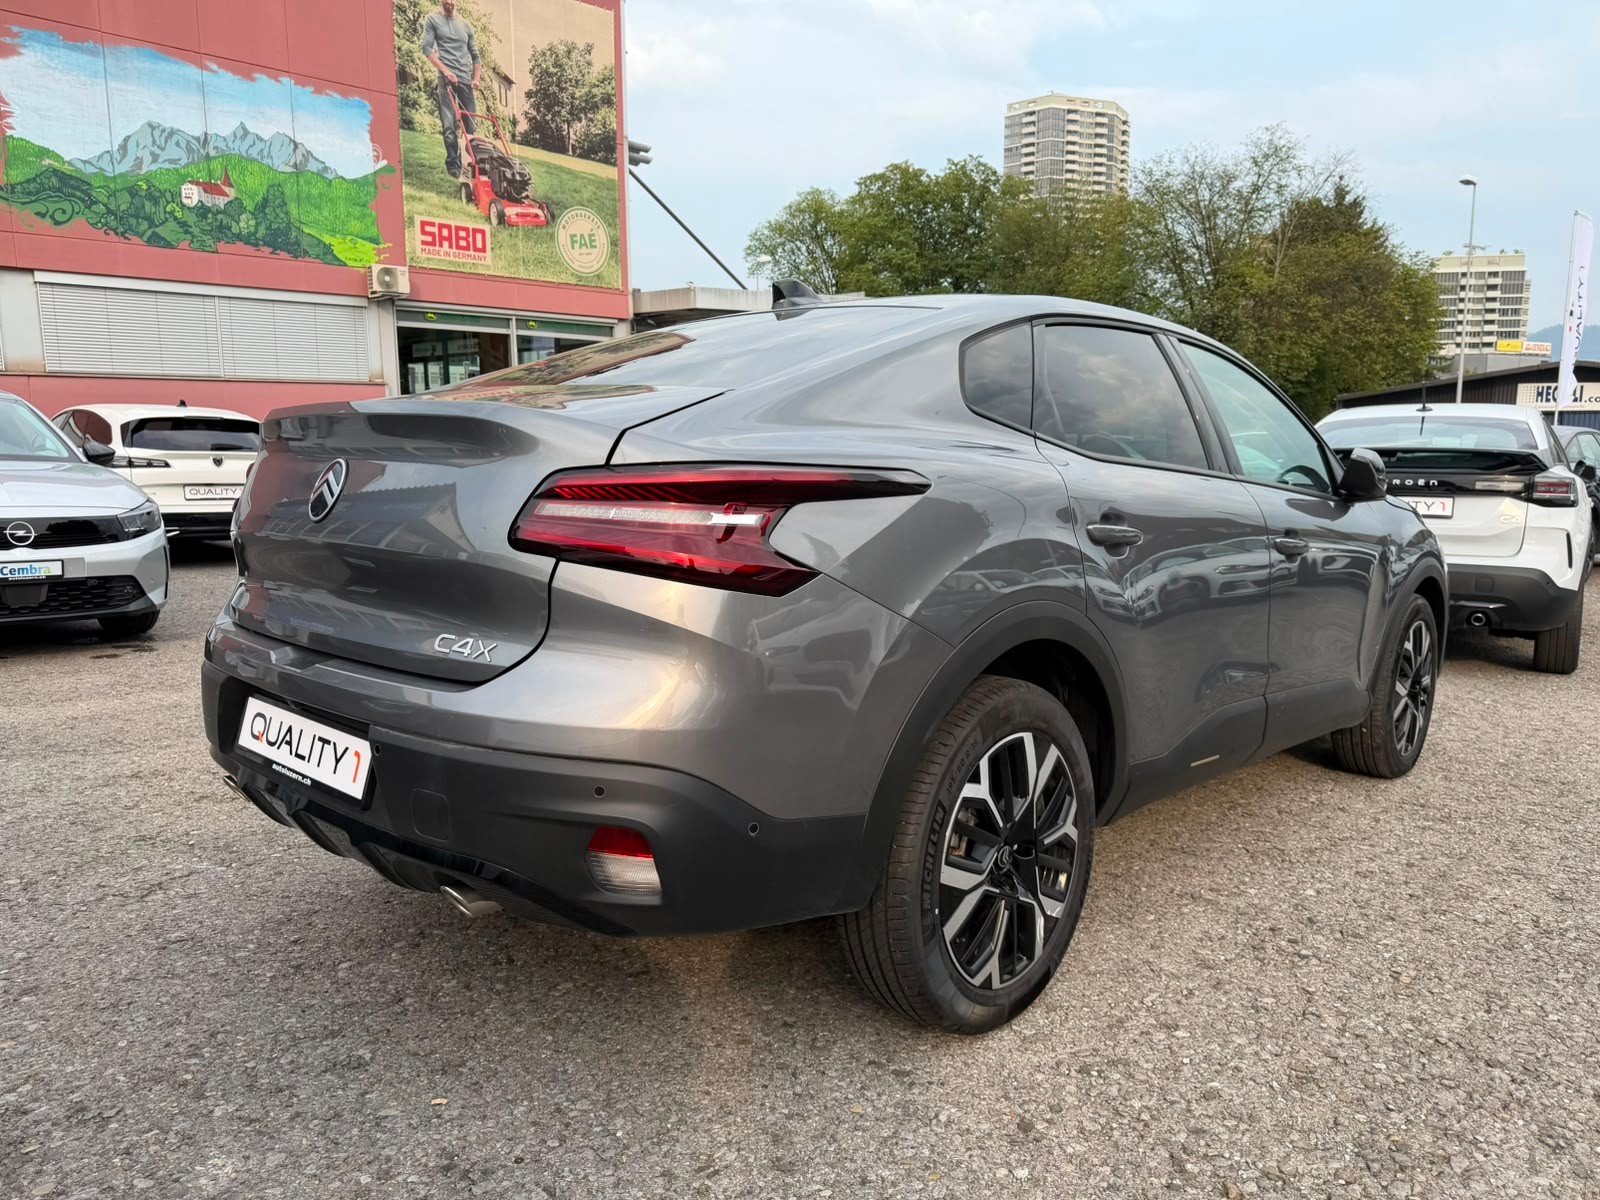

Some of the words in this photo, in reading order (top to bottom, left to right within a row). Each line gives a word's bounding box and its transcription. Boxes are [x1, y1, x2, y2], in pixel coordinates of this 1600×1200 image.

[420, 219, 487, 254] SABO
[420, 247, 442, 257] MADE
[443, 250, 451, 259] IN
[452, 251, 487, 262] GERMANY
[188, 483, 238, 496] QUALITY
[1439, 500, 1446, 512] 1
[0, 564, 52, 576] Cembra
[250, 711, 349, 775] QUALITY
[353, 750, 361, 783] 1
[271, 762, 312, 787] autoluzern.ch
[922, 805, 945, 909] MICHELIN
